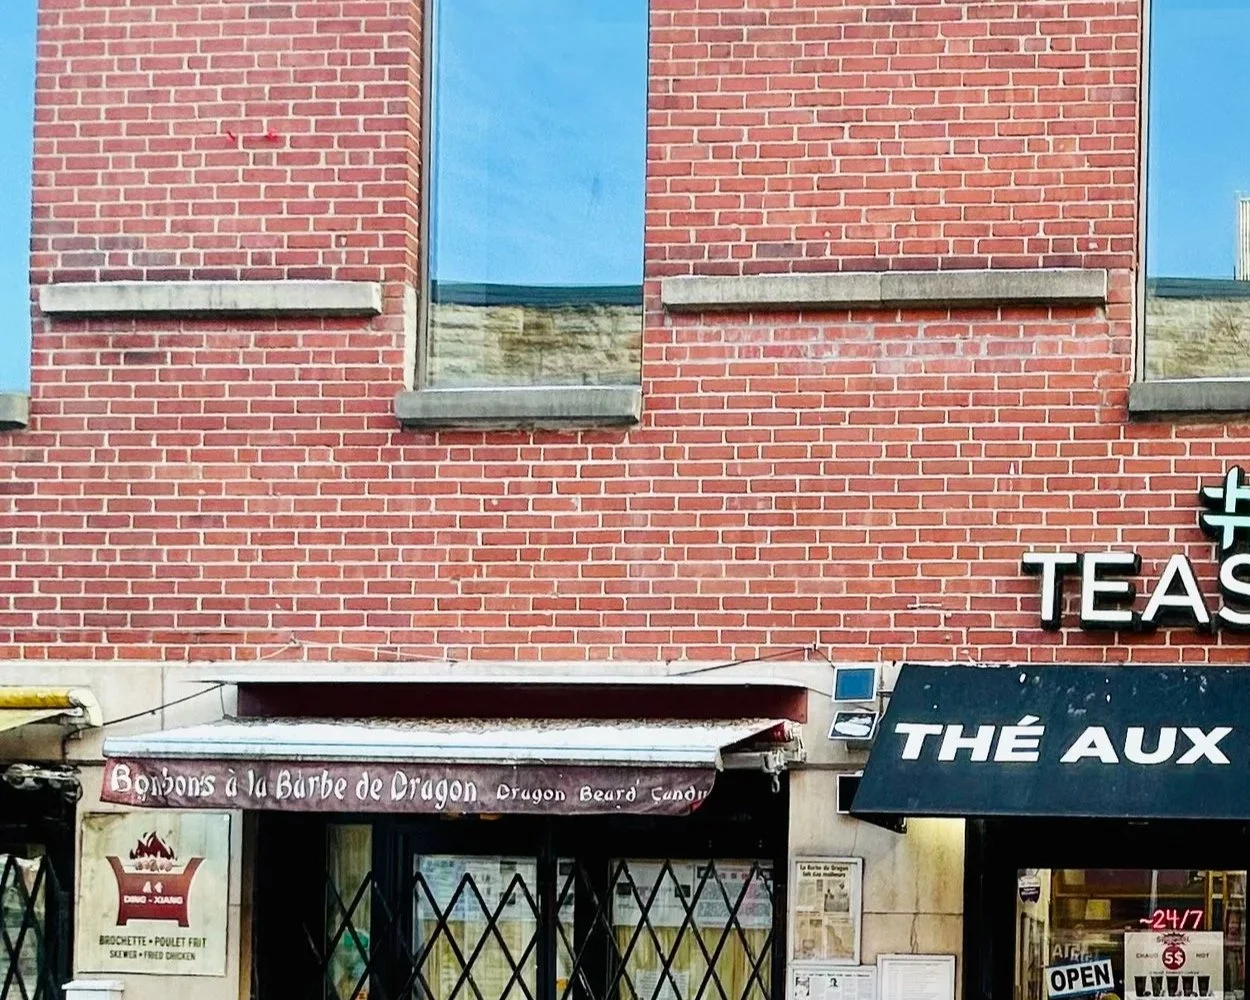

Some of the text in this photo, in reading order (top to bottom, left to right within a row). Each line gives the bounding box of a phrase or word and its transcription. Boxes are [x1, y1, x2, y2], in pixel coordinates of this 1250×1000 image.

[894, 715, 1046, 763] THÉ
[1059, 726, 1234, 765] AUX
[110, 763, 478, 810] Bonbons à la Barbe de Dragon
[496, 783, 566, 805] Dragon
[580, 785, 637, 802] Beard
[154, 896, 184, 905] XIANG
[99, 935, 207, 949] BROCHETTE POULET FRIT
[109, 950, 196, 961] SKEWER FRIED CHICKEN
[1163, 950, 1184, 966] 5$
[1050, 962, 1111, 992] OPEN
